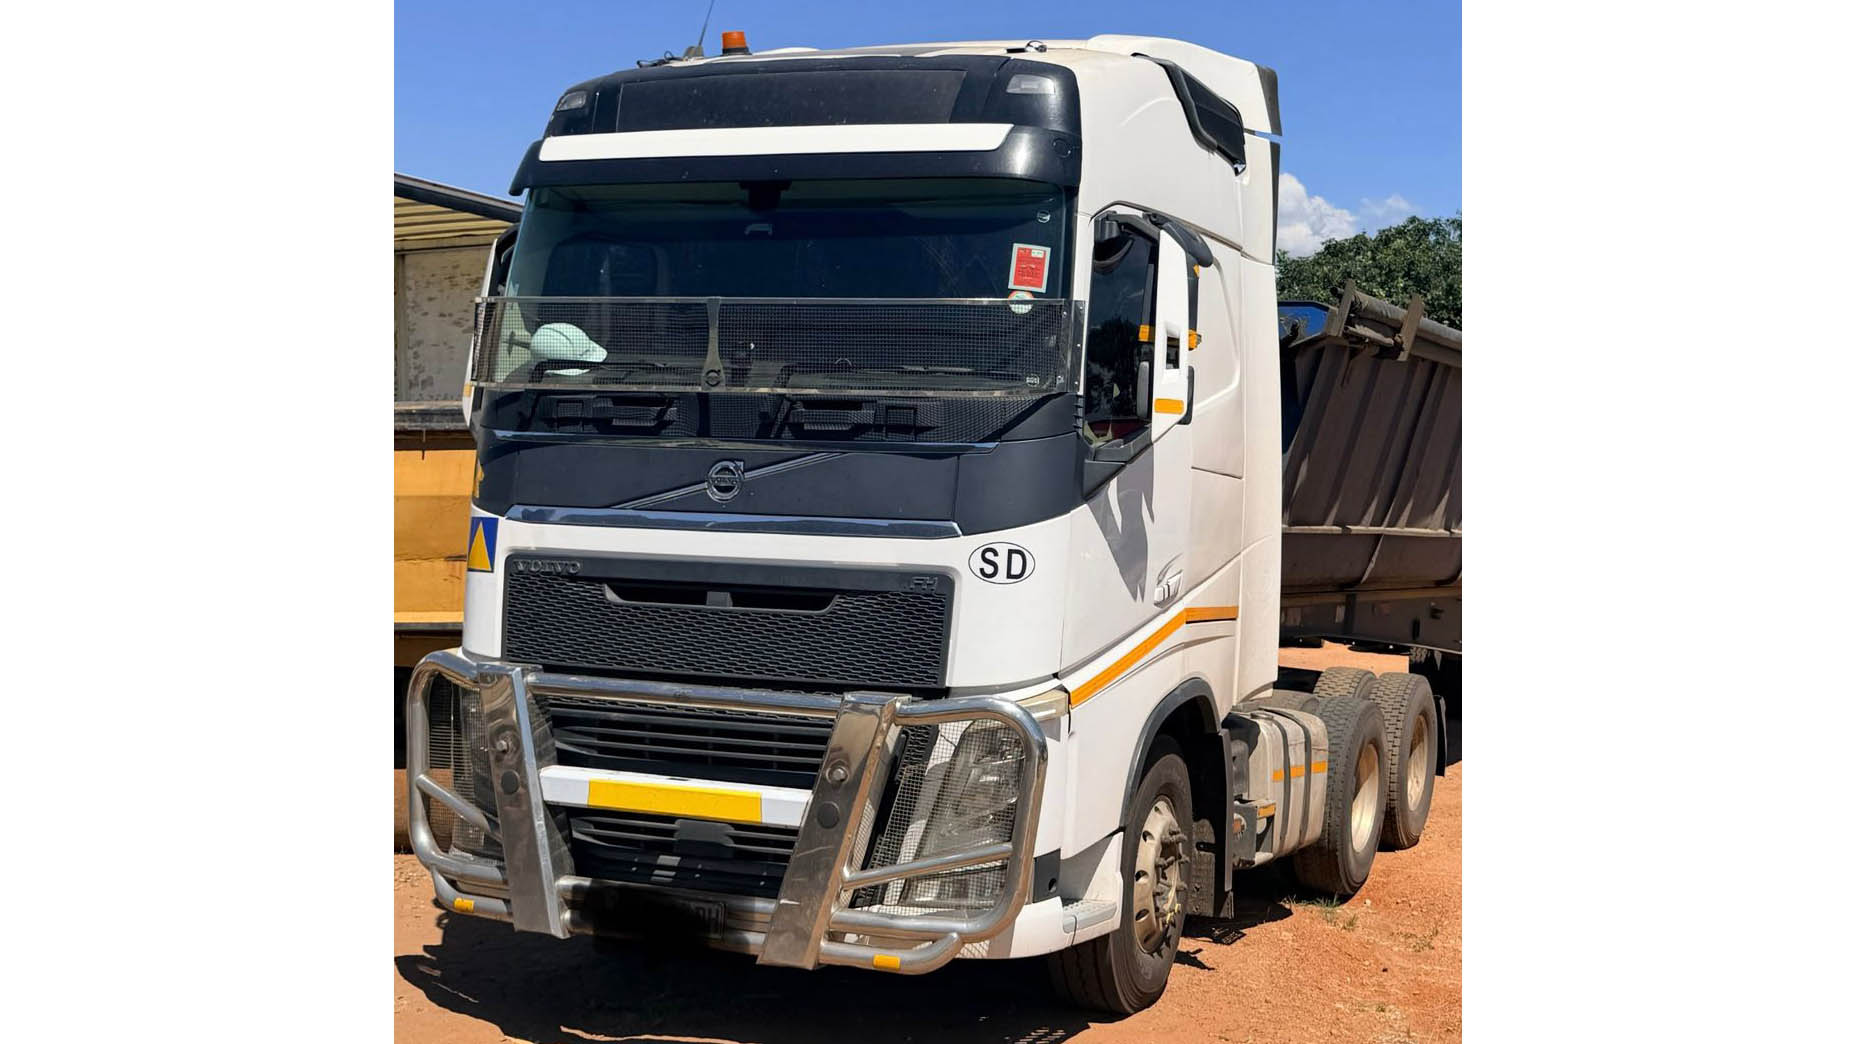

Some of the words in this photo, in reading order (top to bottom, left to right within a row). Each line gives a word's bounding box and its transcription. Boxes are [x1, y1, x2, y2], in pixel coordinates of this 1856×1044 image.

[512, 560, 581, 574] VOLVO
[979, 547, 1027, 580] SD
[909, 576, 938, 592] FH
